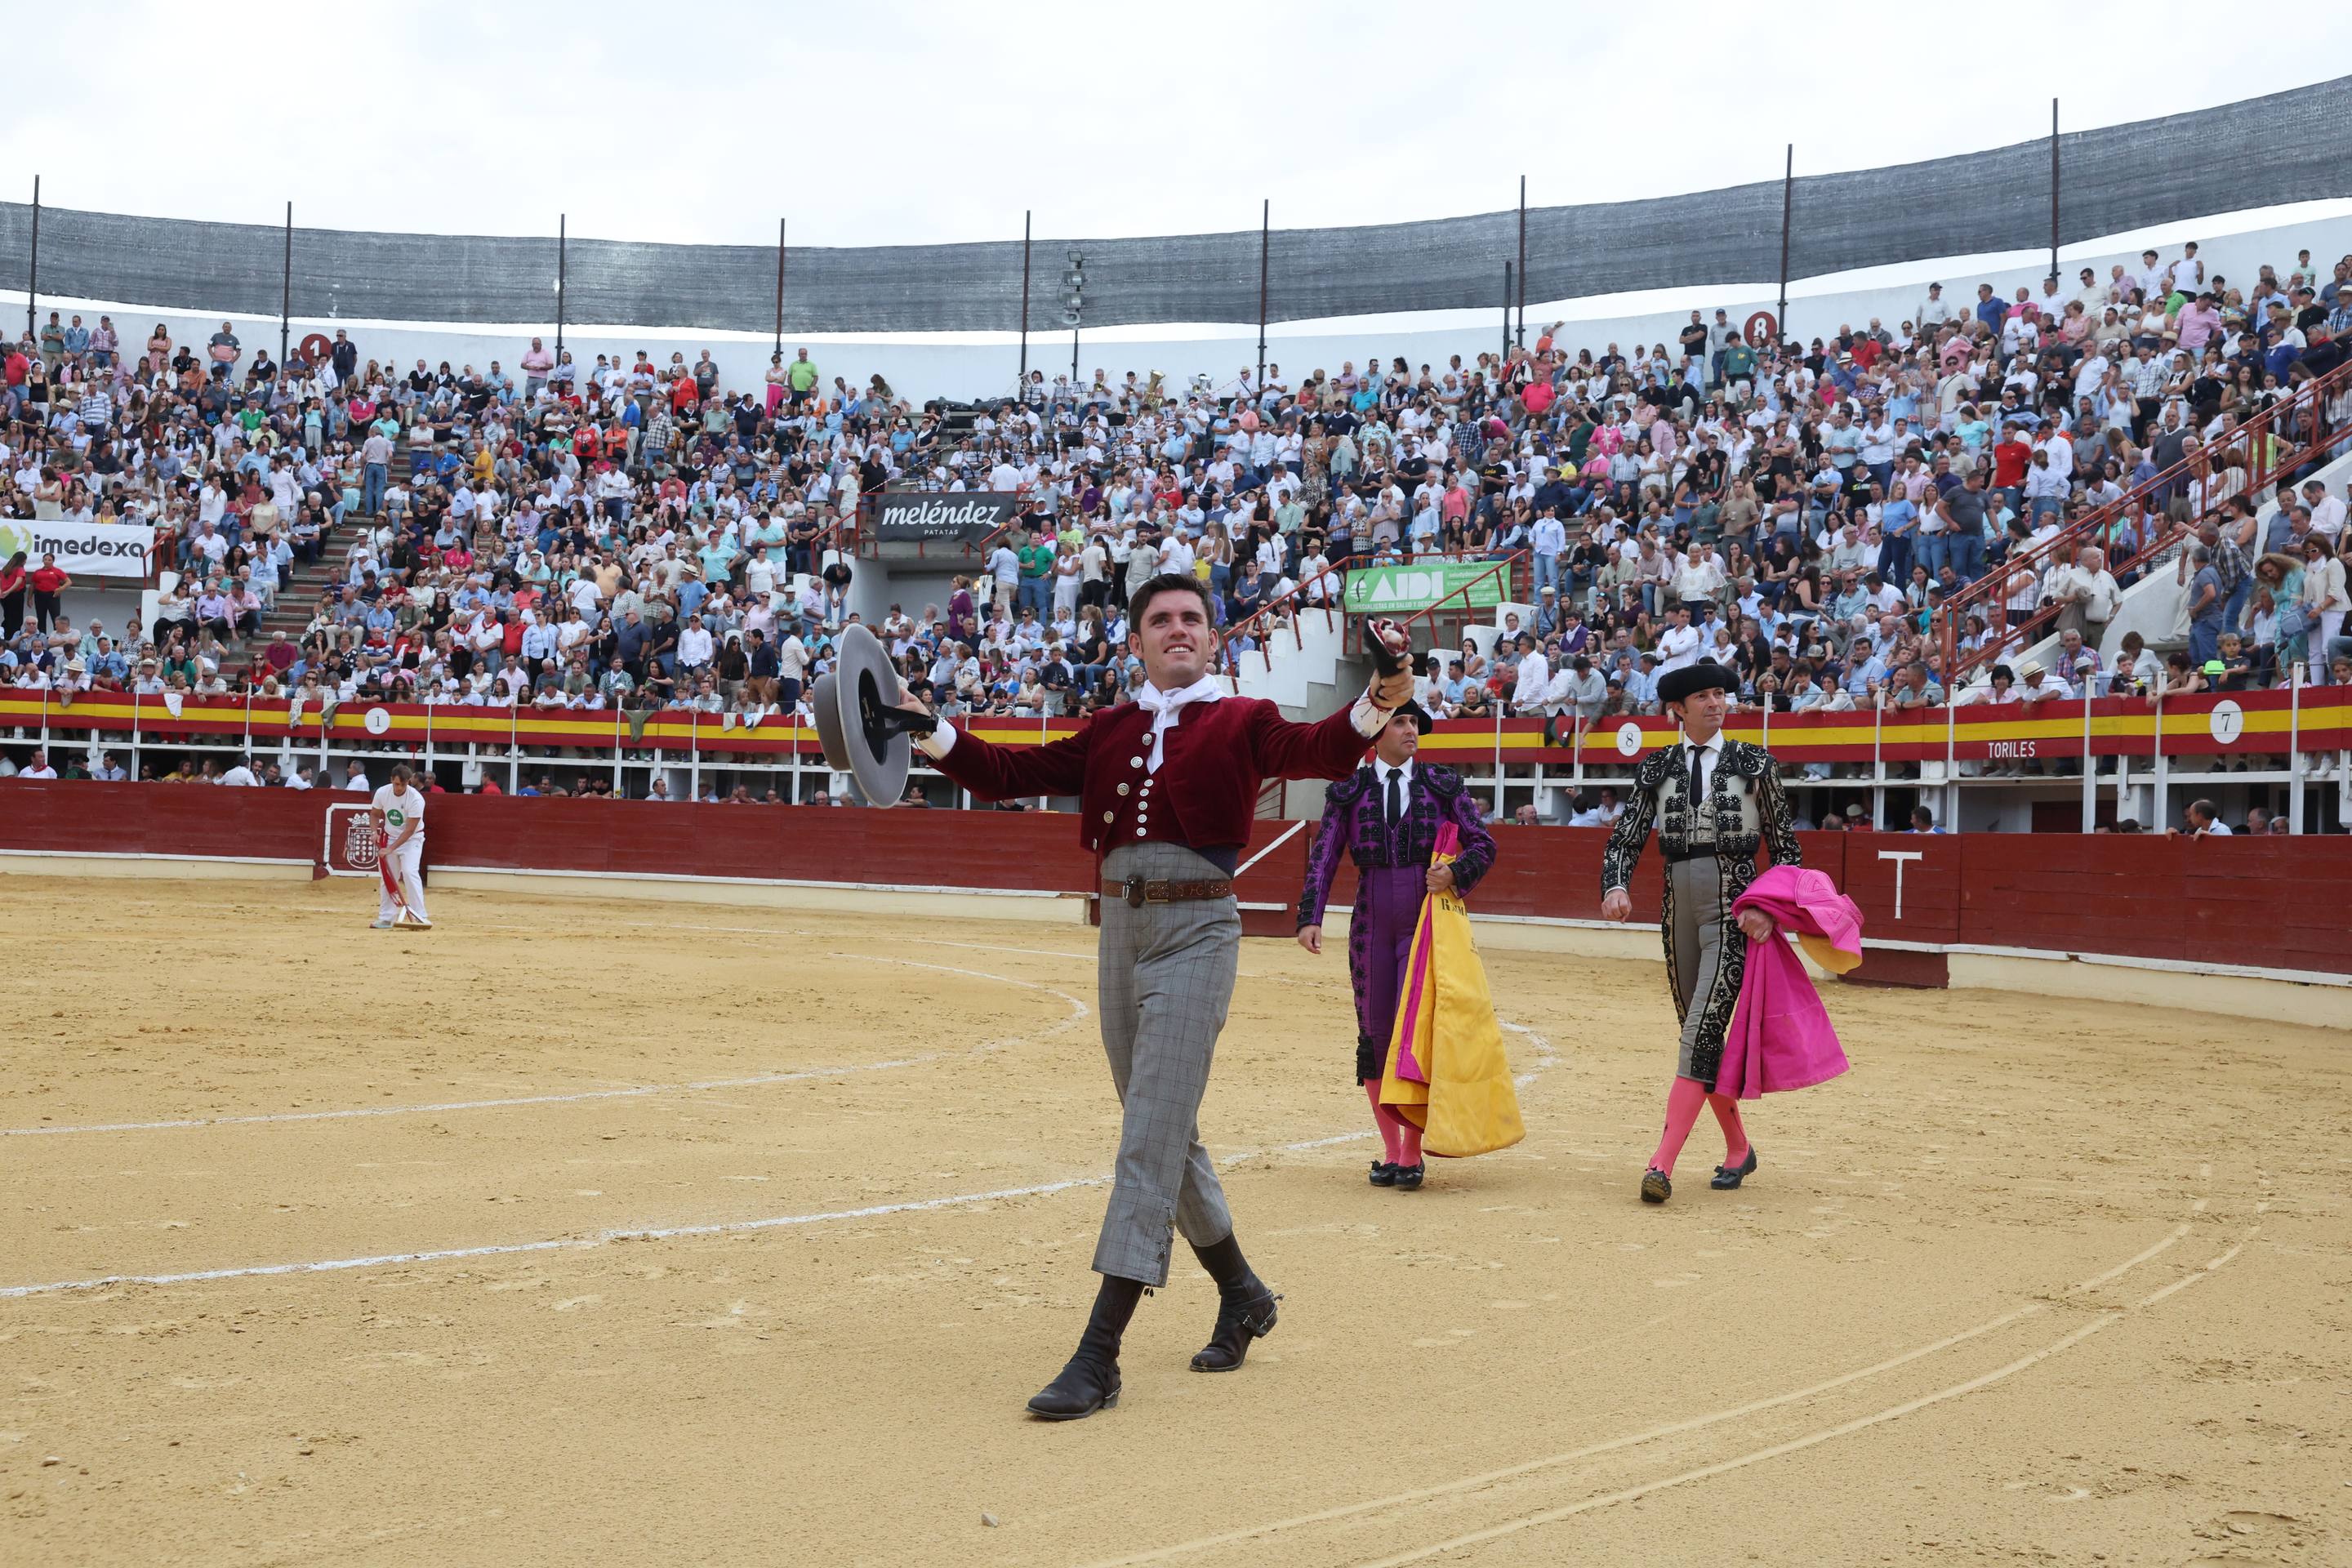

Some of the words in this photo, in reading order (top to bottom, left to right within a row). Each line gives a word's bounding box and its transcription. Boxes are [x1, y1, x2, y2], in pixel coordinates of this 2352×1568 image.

[1753, 318, 1768, 340] 8
[310, 340, 320, 356] 1
[882, 500, 1000, 528] meléndez
[33, 534, 145, 557] imedexa
[375, 715, 381, 727] 1
[2221, 714, 2230, 732] 7
[1626, 732, 1633, 747] 8
[1989, 741, 2036, 758] TORILES
